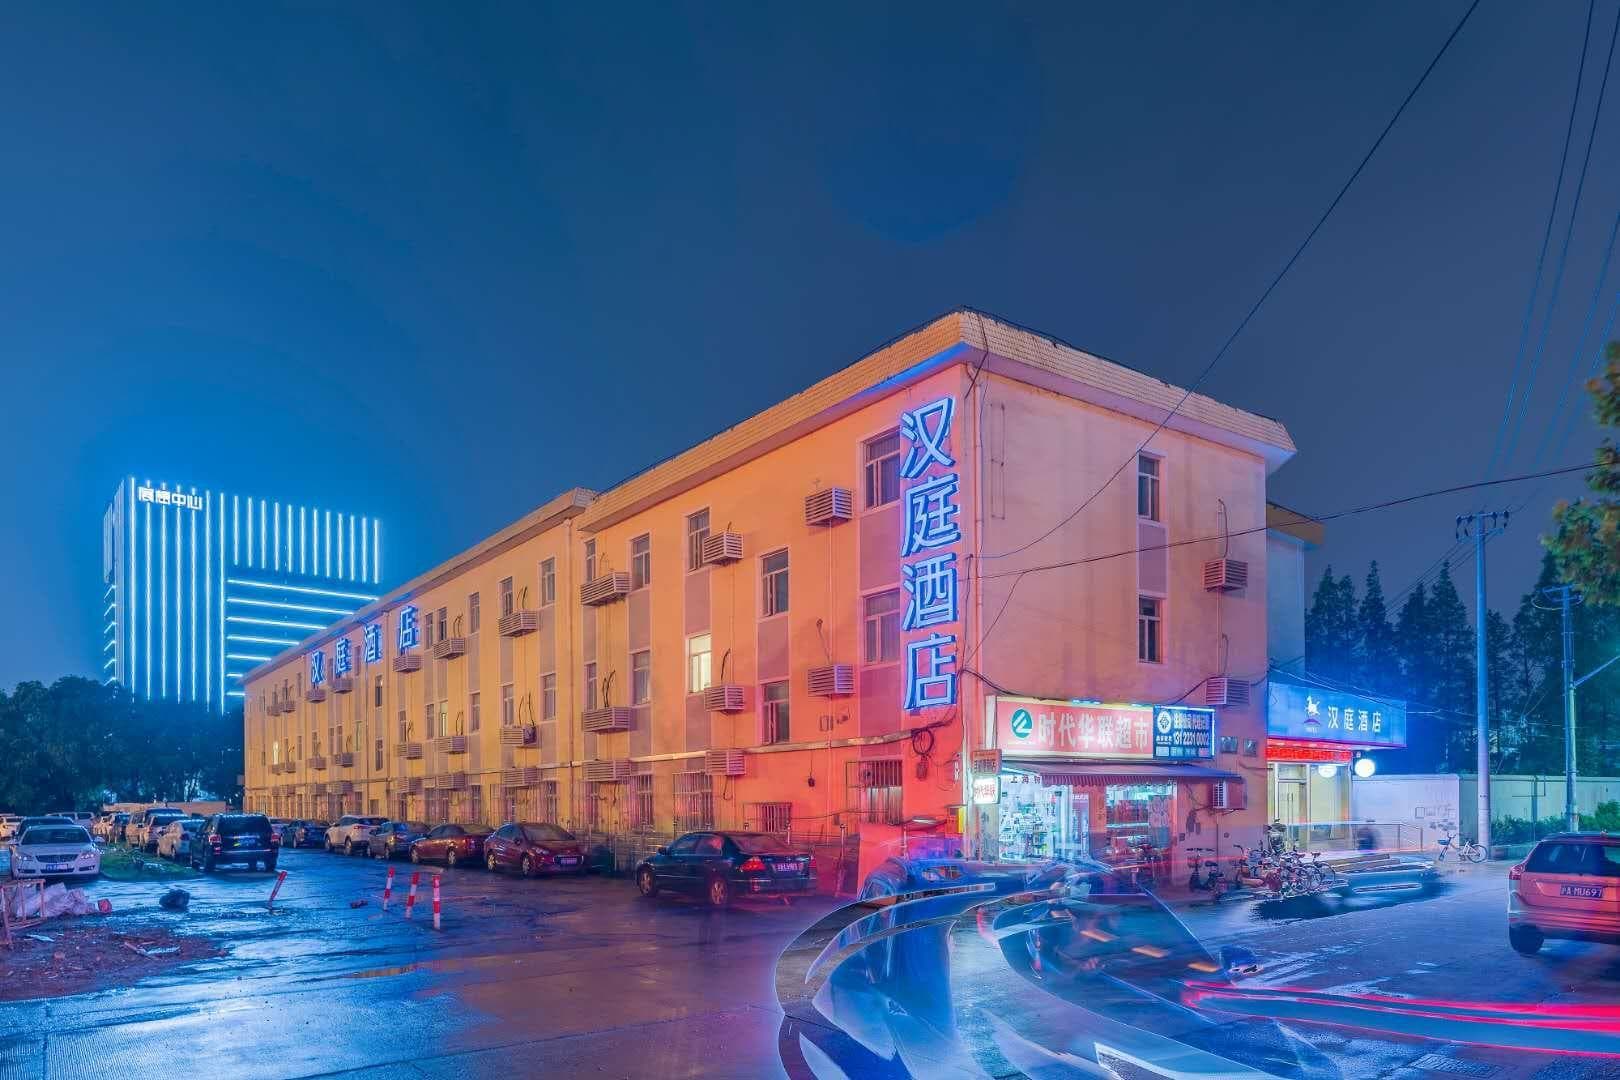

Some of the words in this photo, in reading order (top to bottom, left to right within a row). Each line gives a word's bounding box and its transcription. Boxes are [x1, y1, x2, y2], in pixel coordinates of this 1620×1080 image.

[900, 397, 961, 710] 汉庭酒店
[310, 605, 421, 685] 汉庭酒店
[1038, 711, 1150, 751] 时代华联超市
[1327, 705, 1382, 733] 汉庭酒店
